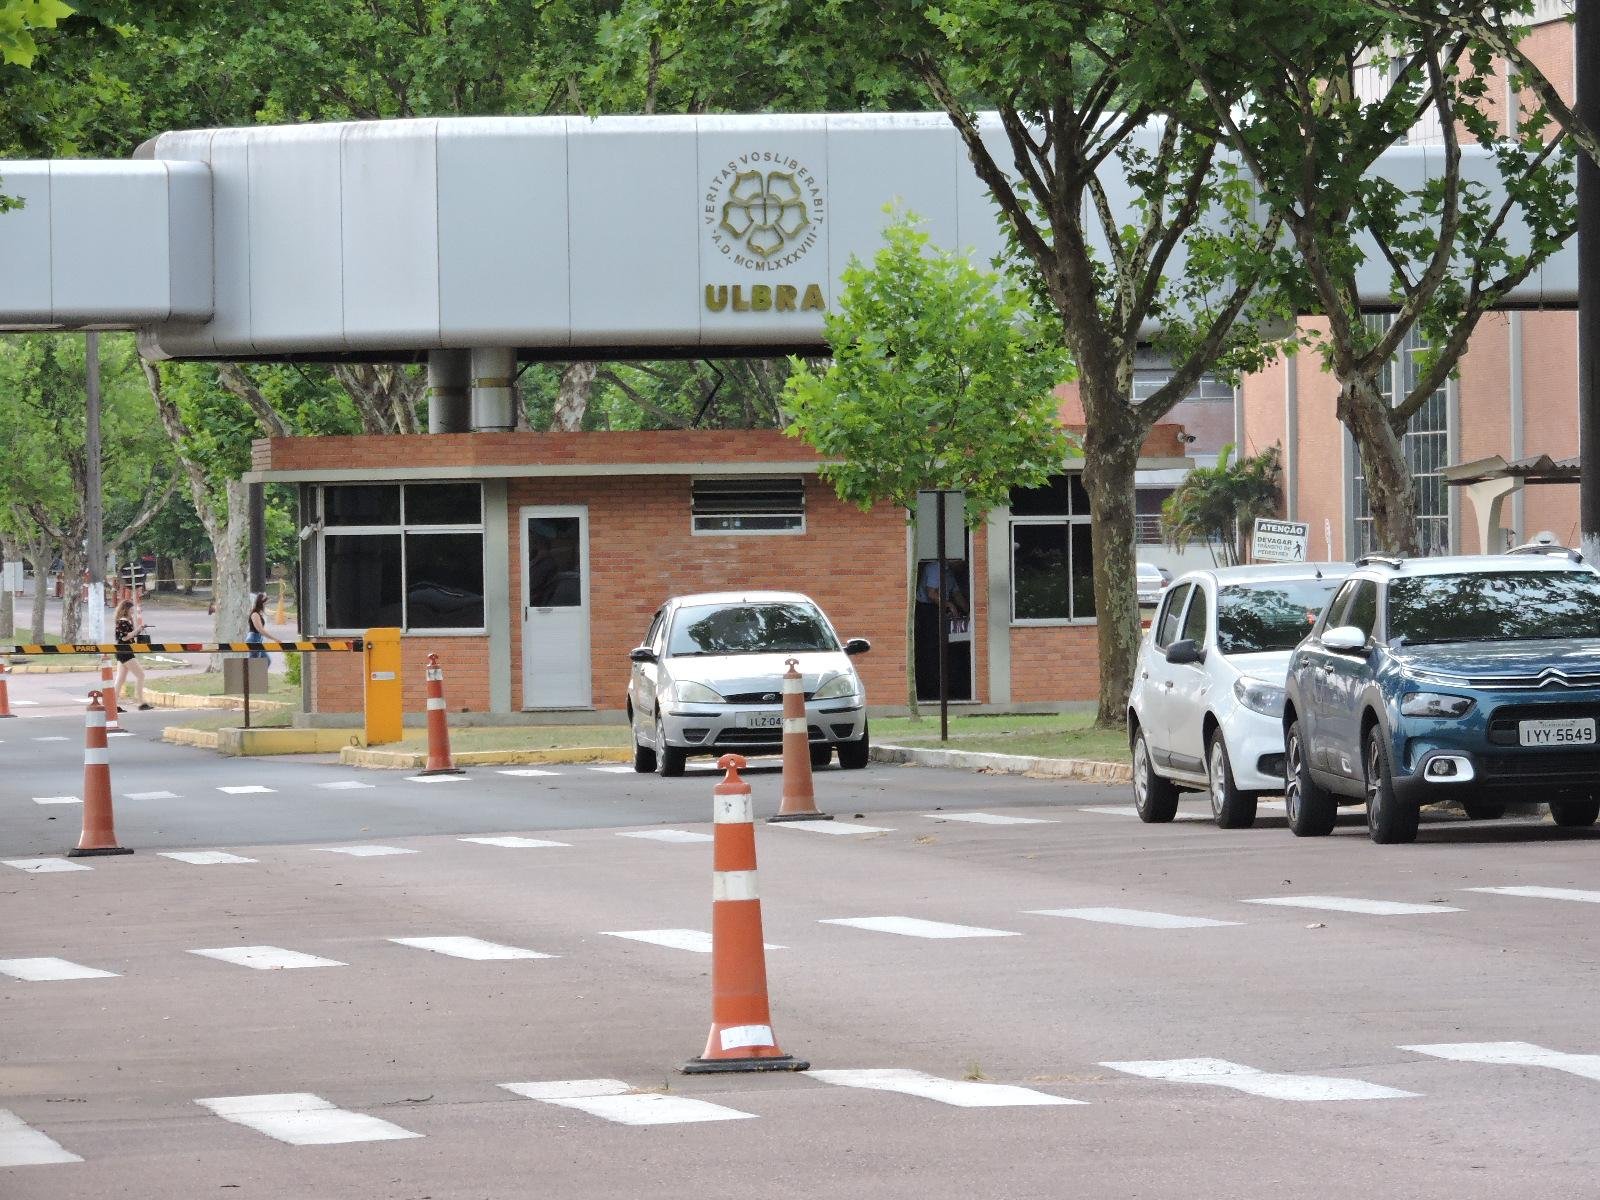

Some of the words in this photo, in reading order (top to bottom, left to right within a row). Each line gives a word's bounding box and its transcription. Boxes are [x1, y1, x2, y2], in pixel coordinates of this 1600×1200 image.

[705, 161, 737, 225] VERITAS
[705, 284, 826, 312] ULBRA
[1260, 523, 1303, 535] ATENÇÃO
[1257, 536, 1292, 545] DEVAGAR
[750, 717, 783, 727] ILZ-04
